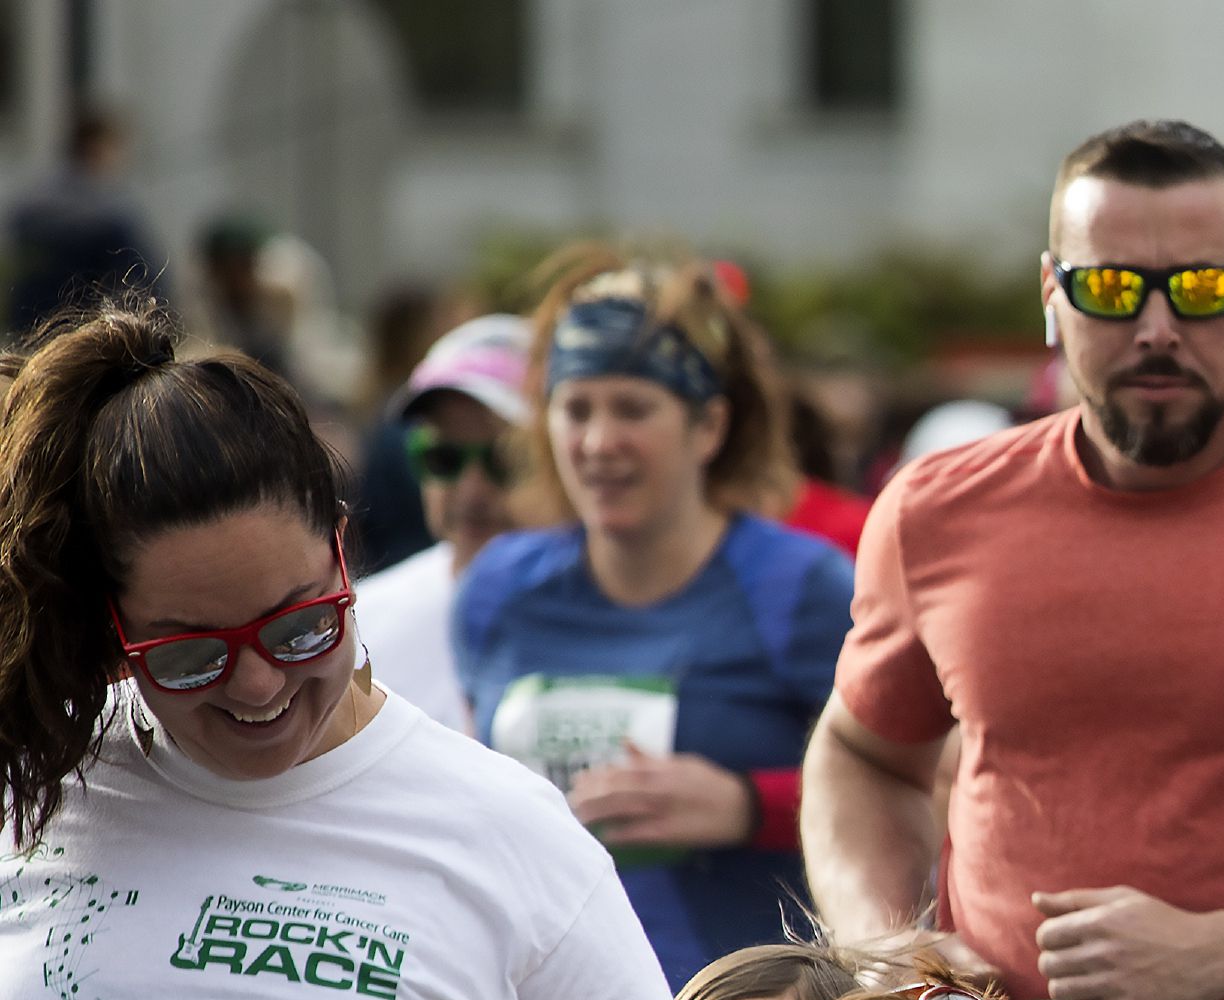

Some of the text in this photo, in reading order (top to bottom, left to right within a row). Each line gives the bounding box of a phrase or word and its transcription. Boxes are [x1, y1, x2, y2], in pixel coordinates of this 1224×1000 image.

[204, 914, 405, 971] ROCK'N
[217, 895, 264, 916] Payson
[267, 900, 310, 919] Center
[313, 907, 333, 922] for
[335, 911, 380, 933] Cancer
[382, 924, 410, 945] Care
